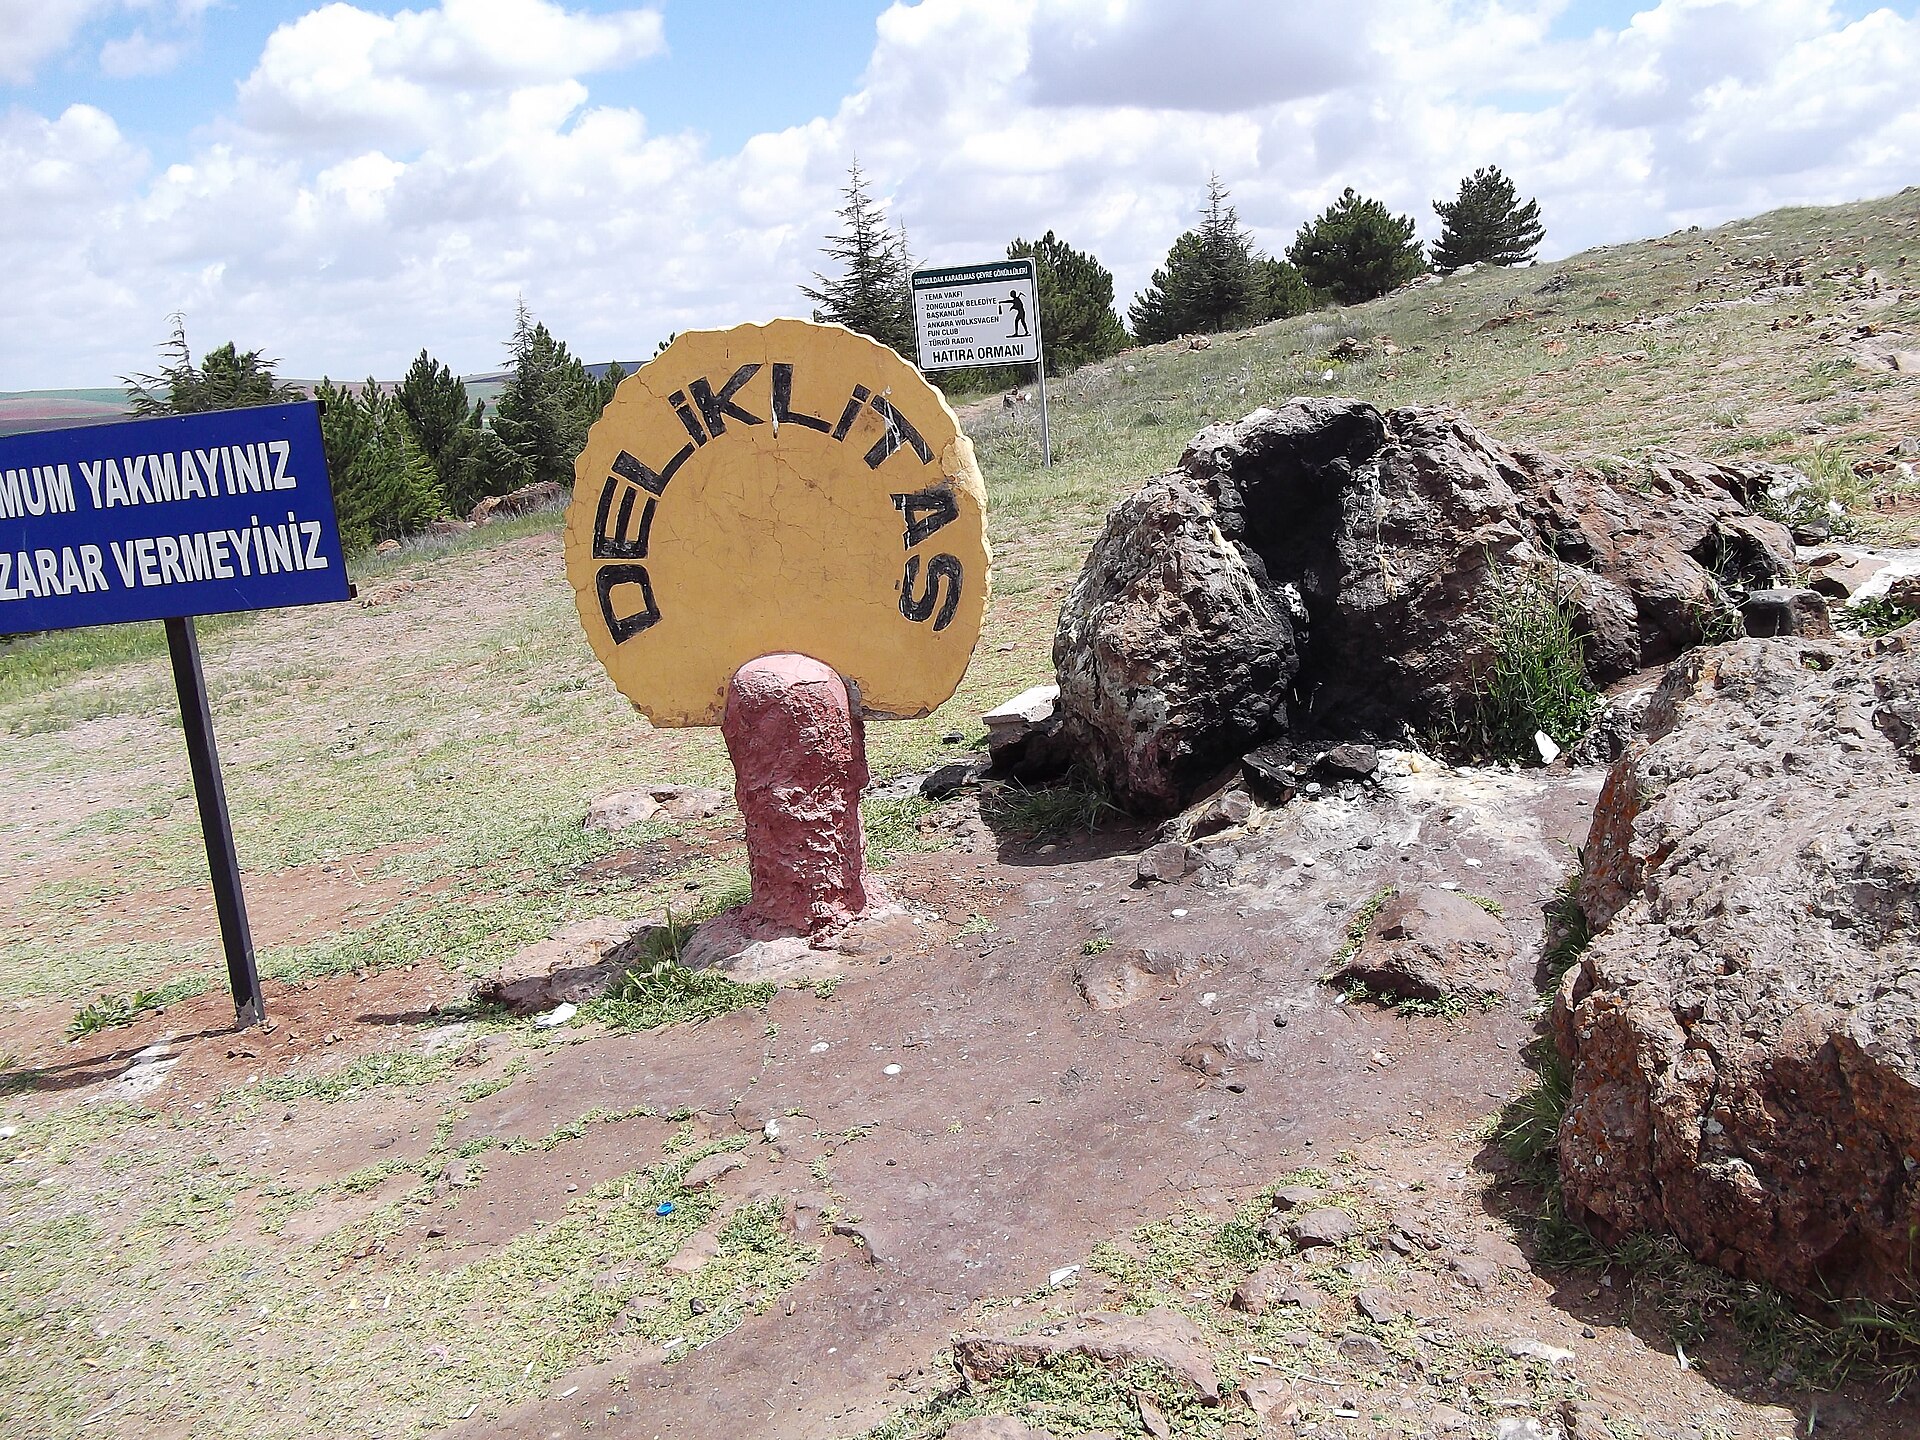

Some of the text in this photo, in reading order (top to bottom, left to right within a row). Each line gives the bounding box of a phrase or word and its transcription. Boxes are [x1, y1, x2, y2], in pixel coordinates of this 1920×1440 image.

[976, 270, 993, 280] ÇEVRE
[926, 297, 997, 310] ZONGULDAK BELEDİYE
[926, 309, 964, 319] BAŞKANLIĞI
[955, 316, 999, 325] WOLKSVAGEN
[933, 344, 1024, 363] HATIRA ORMANI
[0, 440, 297, 519] MUM YAKMAYINIZ
[0, 511, 328, 600] ZARAR VERMEYİNİZ
